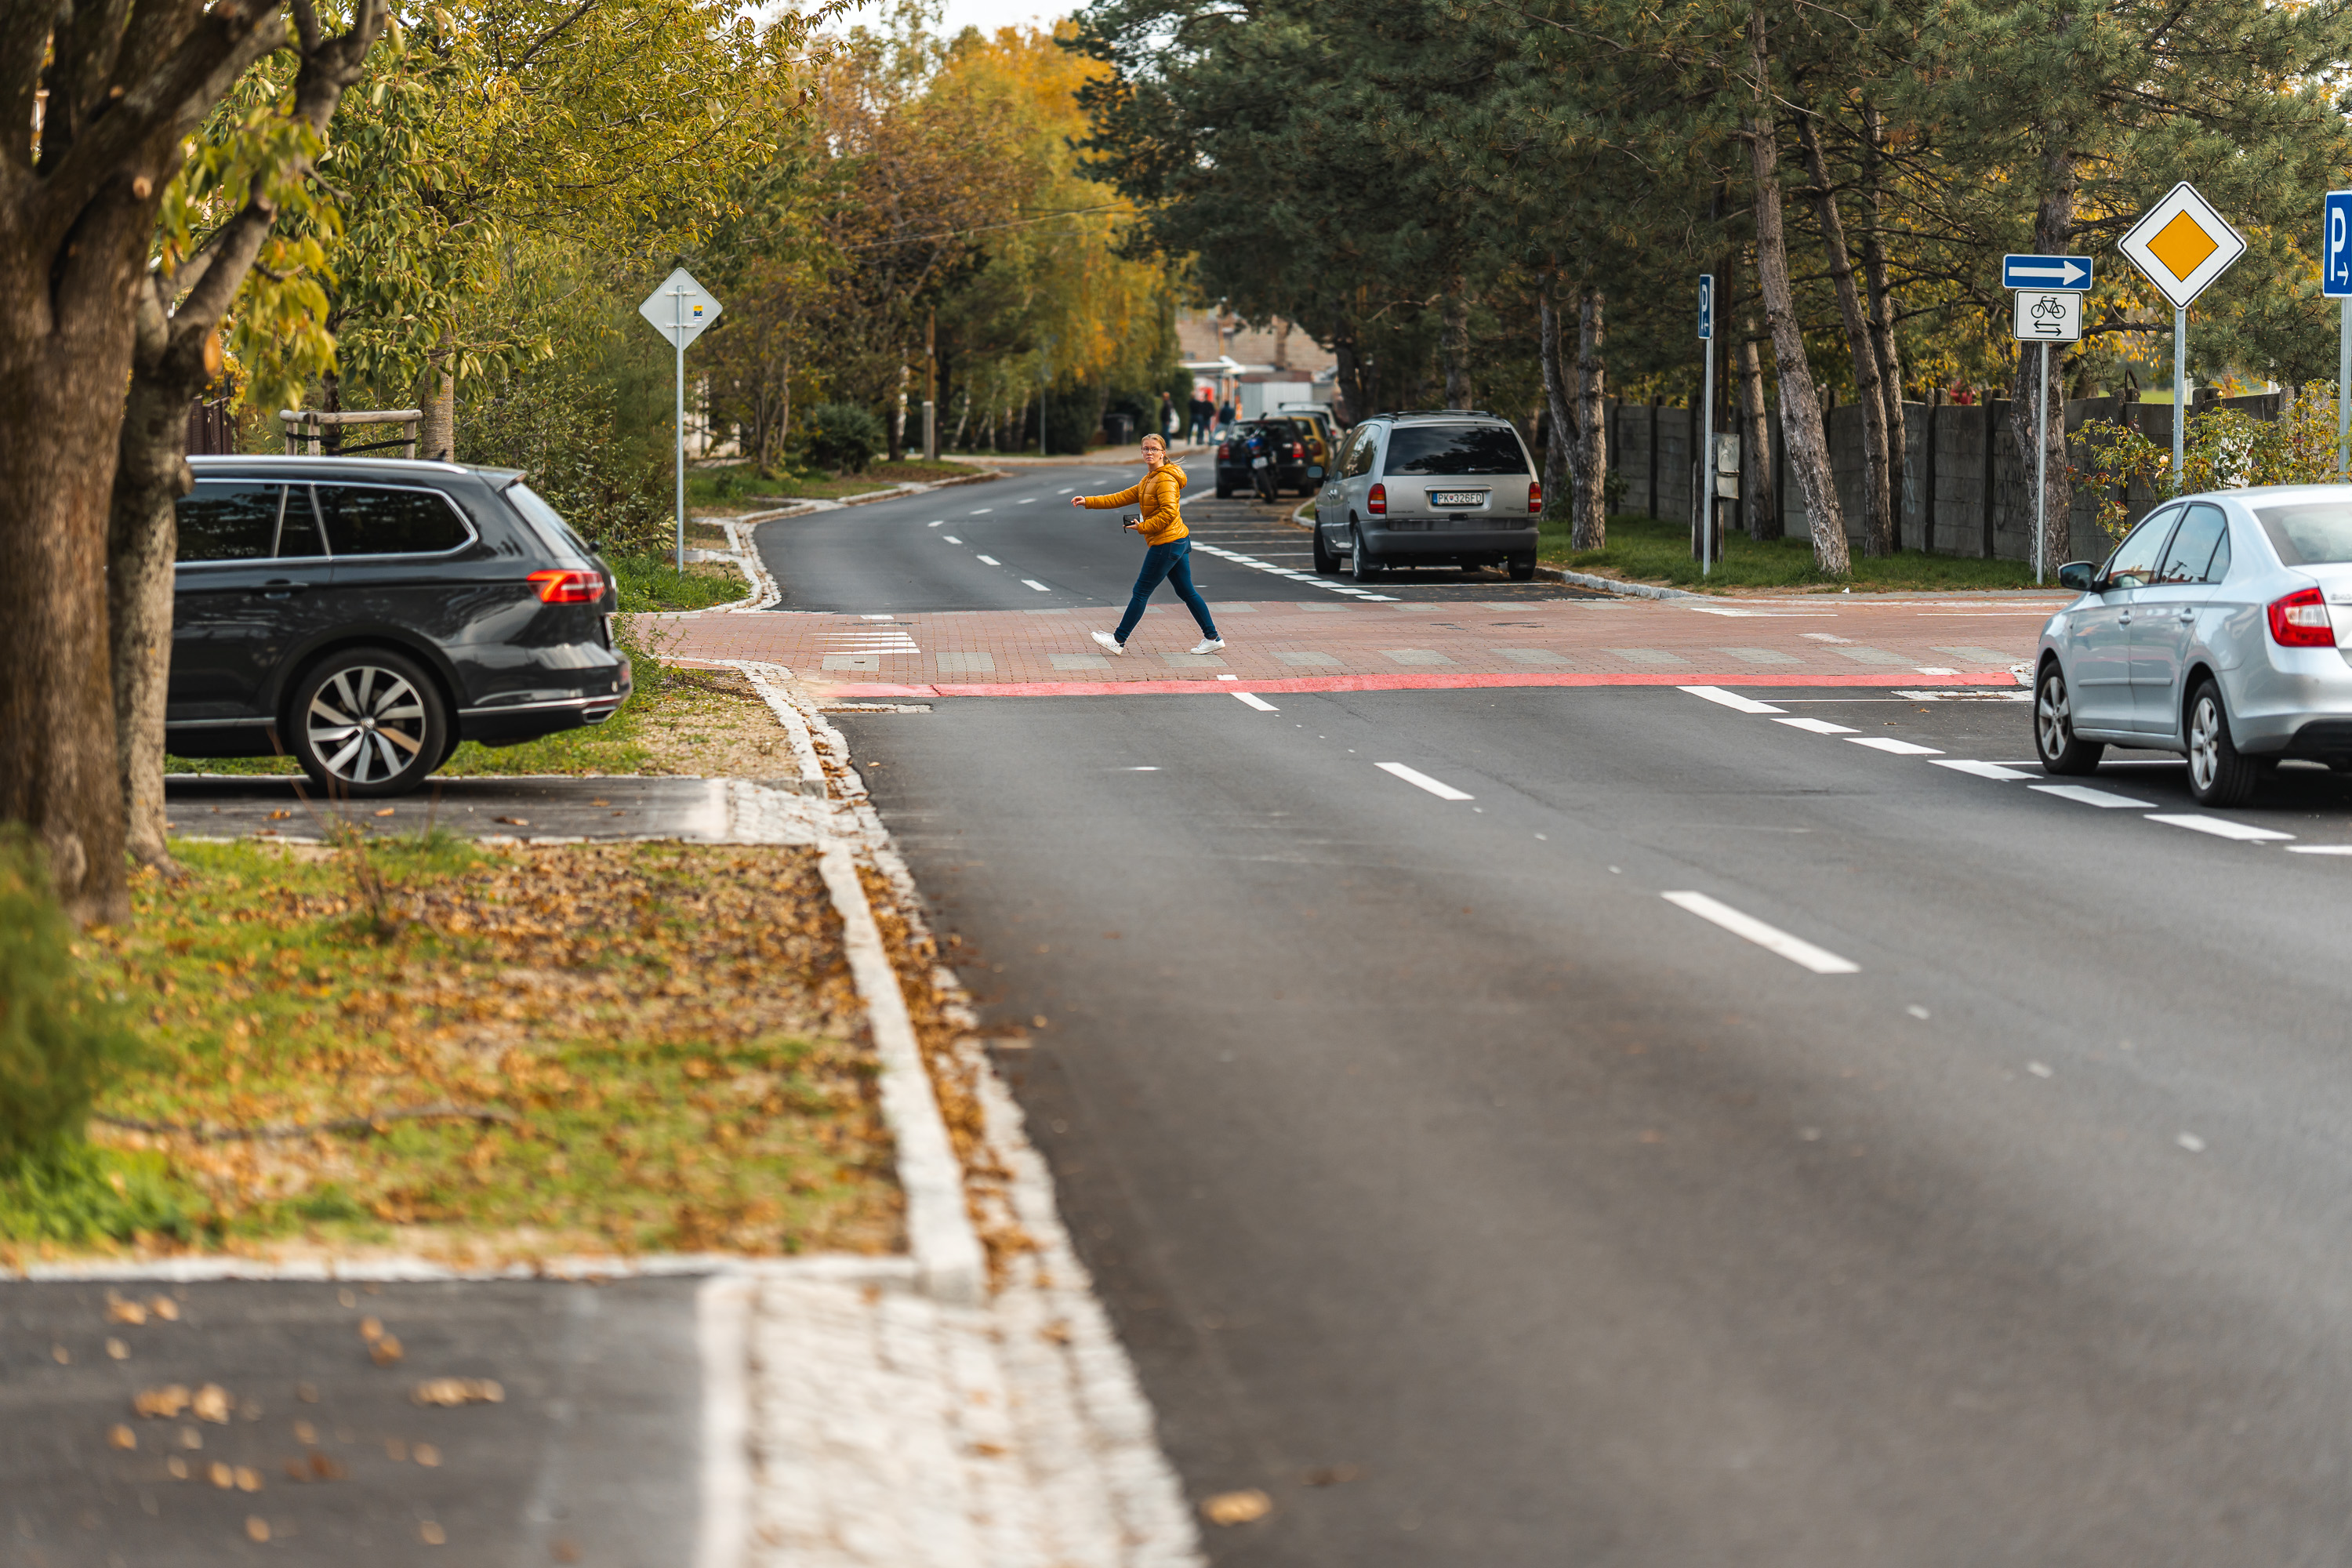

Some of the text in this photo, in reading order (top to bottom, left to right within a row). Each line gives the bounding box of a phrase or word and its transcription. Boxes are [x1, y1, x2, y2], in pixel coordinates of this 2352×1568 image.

[2330, 207, 2347, 281] P
[1701, 284, 1708, 329] P
[1438, 494, 1482, 503] PK 326FD
